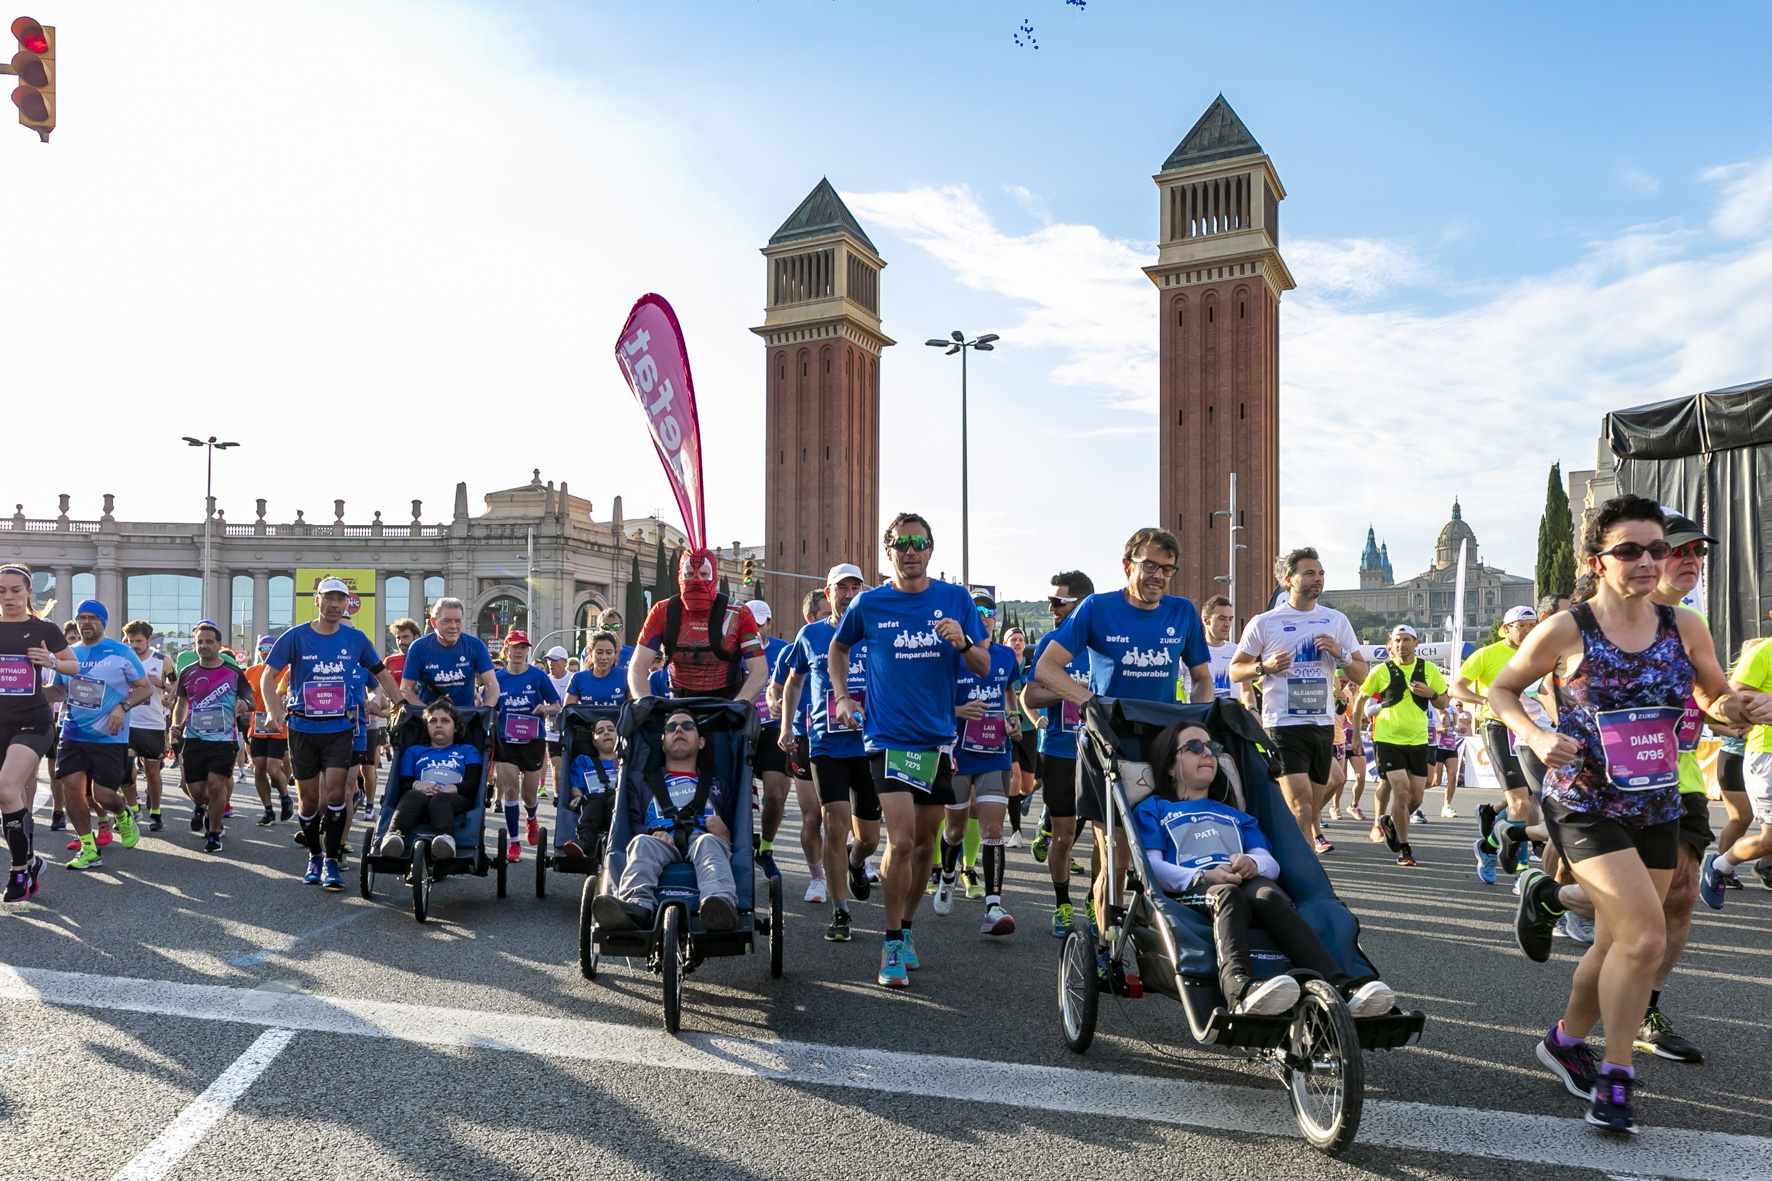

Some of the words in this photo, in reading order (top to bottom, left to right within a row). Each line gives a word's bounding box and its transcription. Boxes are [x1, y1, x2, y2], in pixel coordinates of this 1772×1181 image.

[878, 621, 900, 629] aefat
[1106, 635, 1130, 643] aefat
[895, 651, 941, 660] #Imparables
[1414, 648, 1437, 656] RICH
[78, 660, 111, 669] URICH
[1122, 669, 1169, 679] #Imparables
[1630, 733, 1665, 747] DIANE
[906, 751, 922, 761] ELOI
[1636, 749, 1665, 761] 4795
[904, 760, 921, 771] 7275
